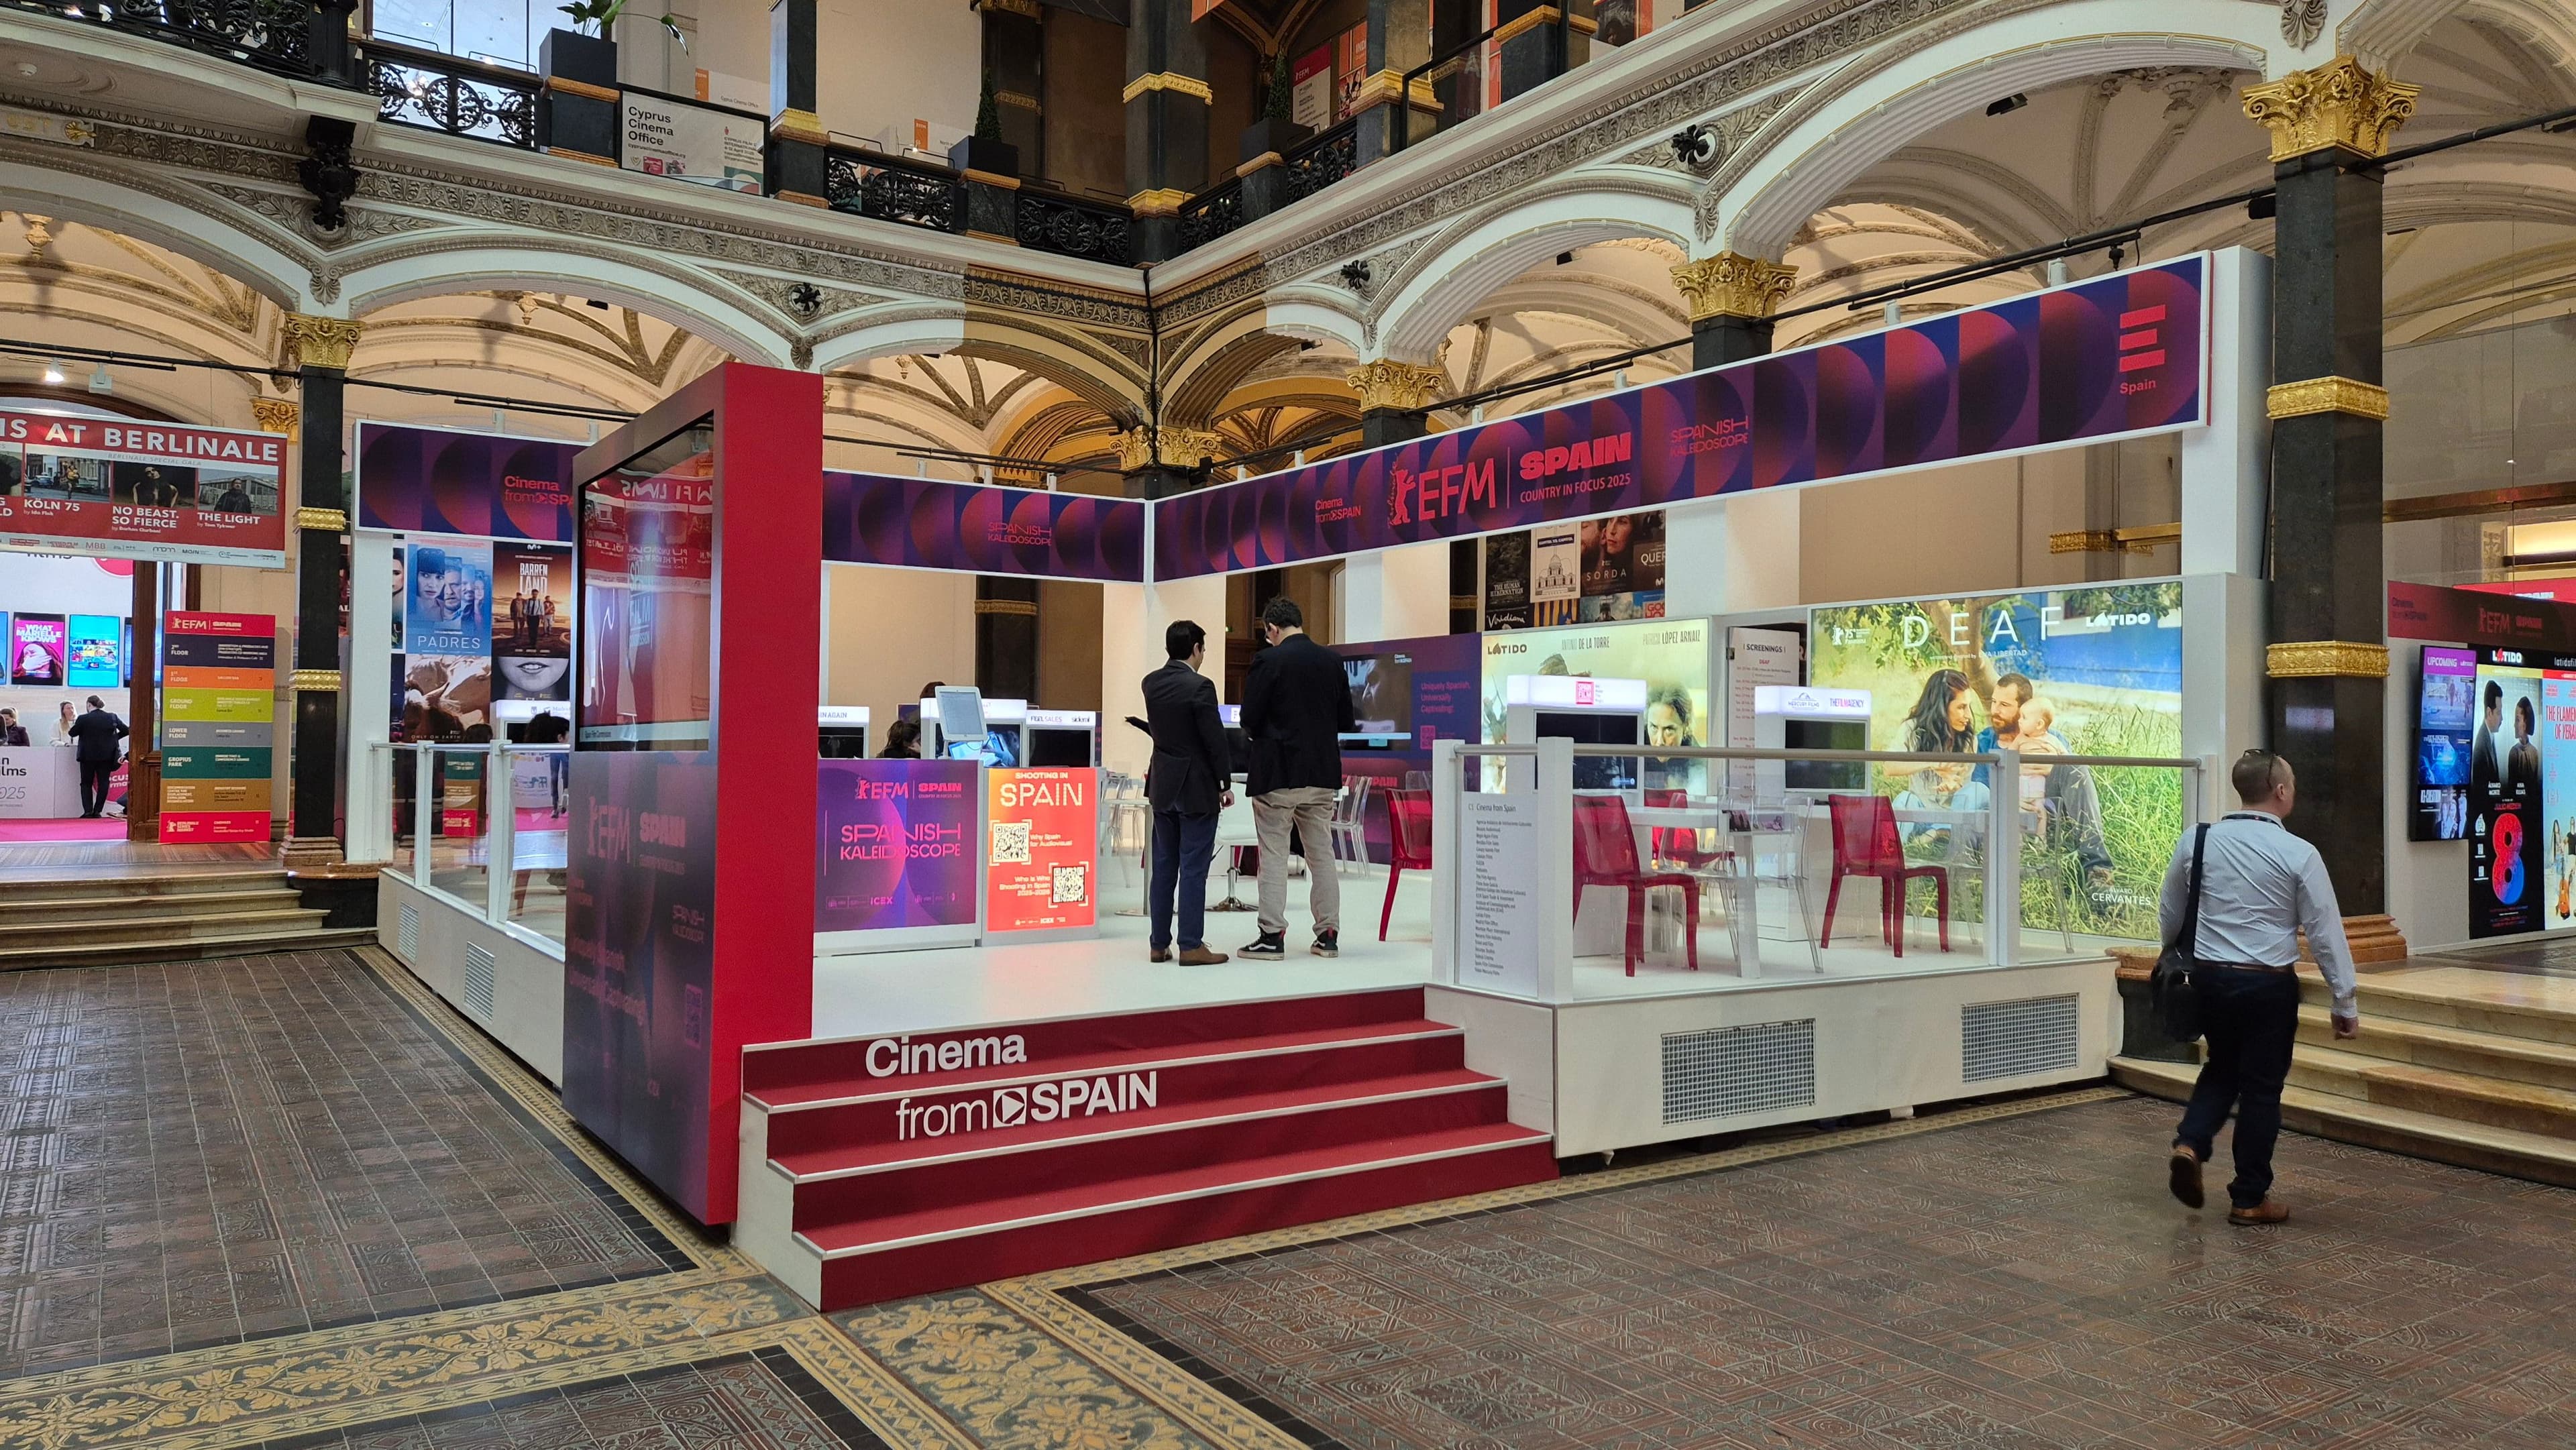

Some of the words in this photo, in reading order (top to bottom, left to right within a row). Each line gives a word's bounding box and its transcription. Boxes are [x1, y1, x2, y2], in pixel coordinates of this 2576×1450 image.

[629, 106, 672, 123] Cyprus
[629, 119, 674, 136] Cinema
[629, 131, 664, 146] Office
[2120, 379, 2157, 395] Spain
[1670, 415, 1750, 443] SPANISH
[45, 423, 87, 444] AT
[104, 427, 278, 462] BERLINALE
[1670, 432, 1749, 457] KALEIDOSCOPE
[504, 474, 560, 492] Cinema
[1418, 457, 1497, 521] EFM
[1519, 431, 1631, 480] SPAIN
[1520, 486, 1561, 503] COUNTRY
[1563, 483, 1573, 495] IN
[1575, 478, 1605, 495] FOCUS
[1607, 473, 1631, 488] 2025
[504, 490, 536, 504] from
[1315, 497, 1343, 510] Cinema
[24, 498, 60, 510] KÖLN
[65, 502, 80, 512] 75
[113, 506, 133, 515] NO
[136, 508, 180, 519] BEAST.
[112, 516, 130, 525] SO
[134, 518, 177, 528] FIERCE
[197, 512, 221, 522] THE
[225, 514, 261, 524] LIGHT
[1316, 510, 1332, 524] from
[1334, 505, 1362, 520] SPAIN
[988, 522, 1052, 536] SPANISH
[86, 541, 107, 549] MBB
[988, 534, 1052, 546] KALEIDOSCOPE
[519, 562, 548, 575] BARREN
[1587, 568, 1627, 581] SORDA
[519, 575, 547, 595] LAND
[25, 624, 54, 632] WHAT
[182, 620, 207, 630] EFM
[21, 635, 57, 643] KNOWS
[418, 635, 480, 649] PADRES
[1578, 638, 1585, 649] DE
[1586, 637, 1592, 649] LA
[1594, 636, 1610, 649] TORRE
[1662, 630, 1678, 645] LÓPEZ
[1680, 629, 1701, 643] ARNAIZ
[1746, 643, 1782, 653] SCREENINGS
[1994, 649, 2027, 657] LIBERTAD
[2427, 657, 2457, 667] UPCOMING
[2546, 706, 2556, 721] THE
[2555, 724, 2561, 739] OF
[0, 786, 26, 799] 025
[871, 782, 908, 799] EFM
[918, 783, 962, 792] SPAIN
[1000, 783, 1082, 807] SPAIN
[639, 812, 686, 848] SPAIN
[841, 822, 961, 844] SPANISH
[840, 844, 961, 860] KALEIDOSCOPE
[2492, 813, 2524, 905] 8
[870, 896, 894, 905] ICEX
[2091, 892, 2151, 906] CERVANTES
[865, 1034, 1027, 1077] Cinema
[896, 1098, 988, 1140] from
[1030, 1070, 1157, 1122] SPAIN
